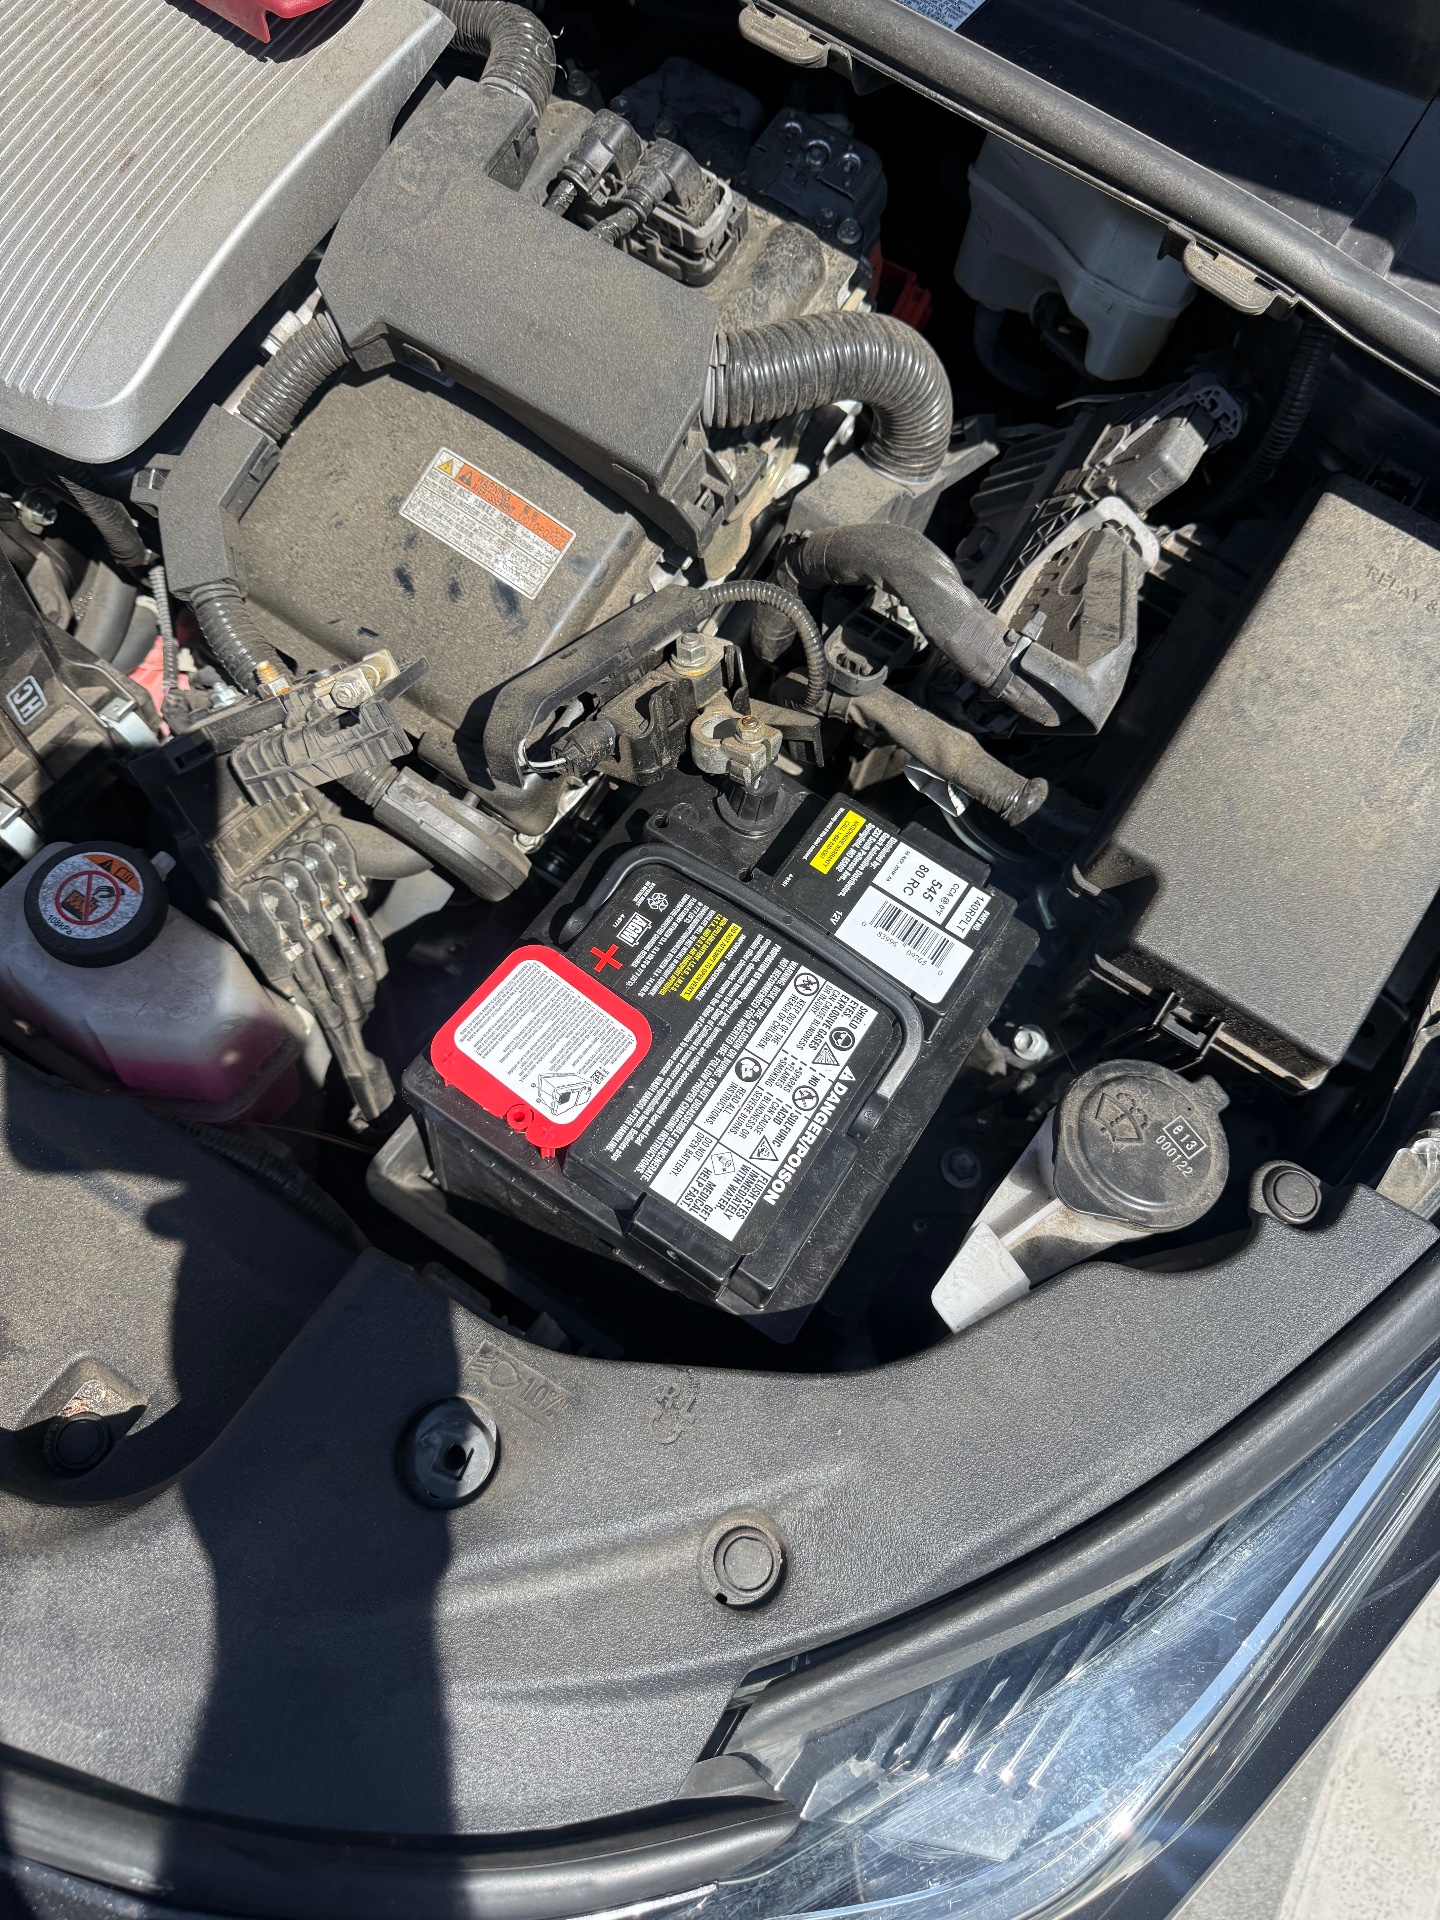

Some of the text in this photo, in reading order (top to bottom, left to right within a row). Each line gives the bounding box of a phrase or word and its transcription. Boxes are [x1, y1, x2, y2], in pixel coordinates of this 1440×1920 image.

[1366, 566, 1423, 603] RELAY
[902, 863, 930, 896] 80 RC
[921, 878, 942, 902] 545
[945, 881, 960, 897] CCA
[48, 914, 72, 936] 108kPa
[619, 915, 647, 943] AGM
[828, 909, 843, 925] 12V
[956, 895, 984, 931] 140RPLT
[876, 930, 898, 948] 83996
[905, 948, 927, 966] 09765
[809, 984, 832, 1014] OR INJURY.
[841, 999, 858, 1020] EYES.
[756, 993, 798, 1050] REACH OF CHILDREN.
[771, 998, 806, 1044] KEEP OUT OF THE
[795, 988, 840, 1050] CAN CAUSE BLINDNESS
[808, 994, 849, 1050] EXPLOSIVE GASES
[848, 1005, 868, 1029] SHIELD
[633, 957, 789, 1175] NOT RECOMMENDED FOR INVERTED USE. FOLLOW PROPER CHARGING INSTRUCTIONS.
[639, 959, 798, 1183] WARNING: RISK OF FIRE, EXPLOSION OR BURNS. DO NOT DISASSEMBLE OR INCINERATE.
[764, 1058, 786, 1087] SMOKING
[774, 1064, 794, 1088] FLAMES
[782, 1068, 802, 1092] SPARKS
[807, 1074, 819, 1086] NO
[704, 1081, 738, 1126] INSTRUCTIONS.
[723, 1086, 746, 1114] READ ALL
[727, 1089, 762, 1136] SEVERE BURNS.
[738, 1095, 770, 1139] BLINDNESS OR
[753, 1101, 779, 1134] CAN CAUSE
[772, 1106, 788, 1125] ACID
[761, 1080, 848, 1205] DANGER/POISON
[771, 1112, 798, 1147] SULFURIC
[669, 1131, 704, 1177] OPEN BATTERY.
[692, 1136, 712, 1160] DO NOT
[1156, 1134, 1194, 1178] 000122
[680, 1167, 712, 1208] HELP FAST.
[689, 1180, 716, 1214] MEDICAL
[714, 1163, 750, 1212] WITH WATER.
[722, 1169, 759, 1219] IMMEDIATELY
[735, 1175, 768, 1219] FLUSH EYES
[698, 1204, 713, 1220] GET
